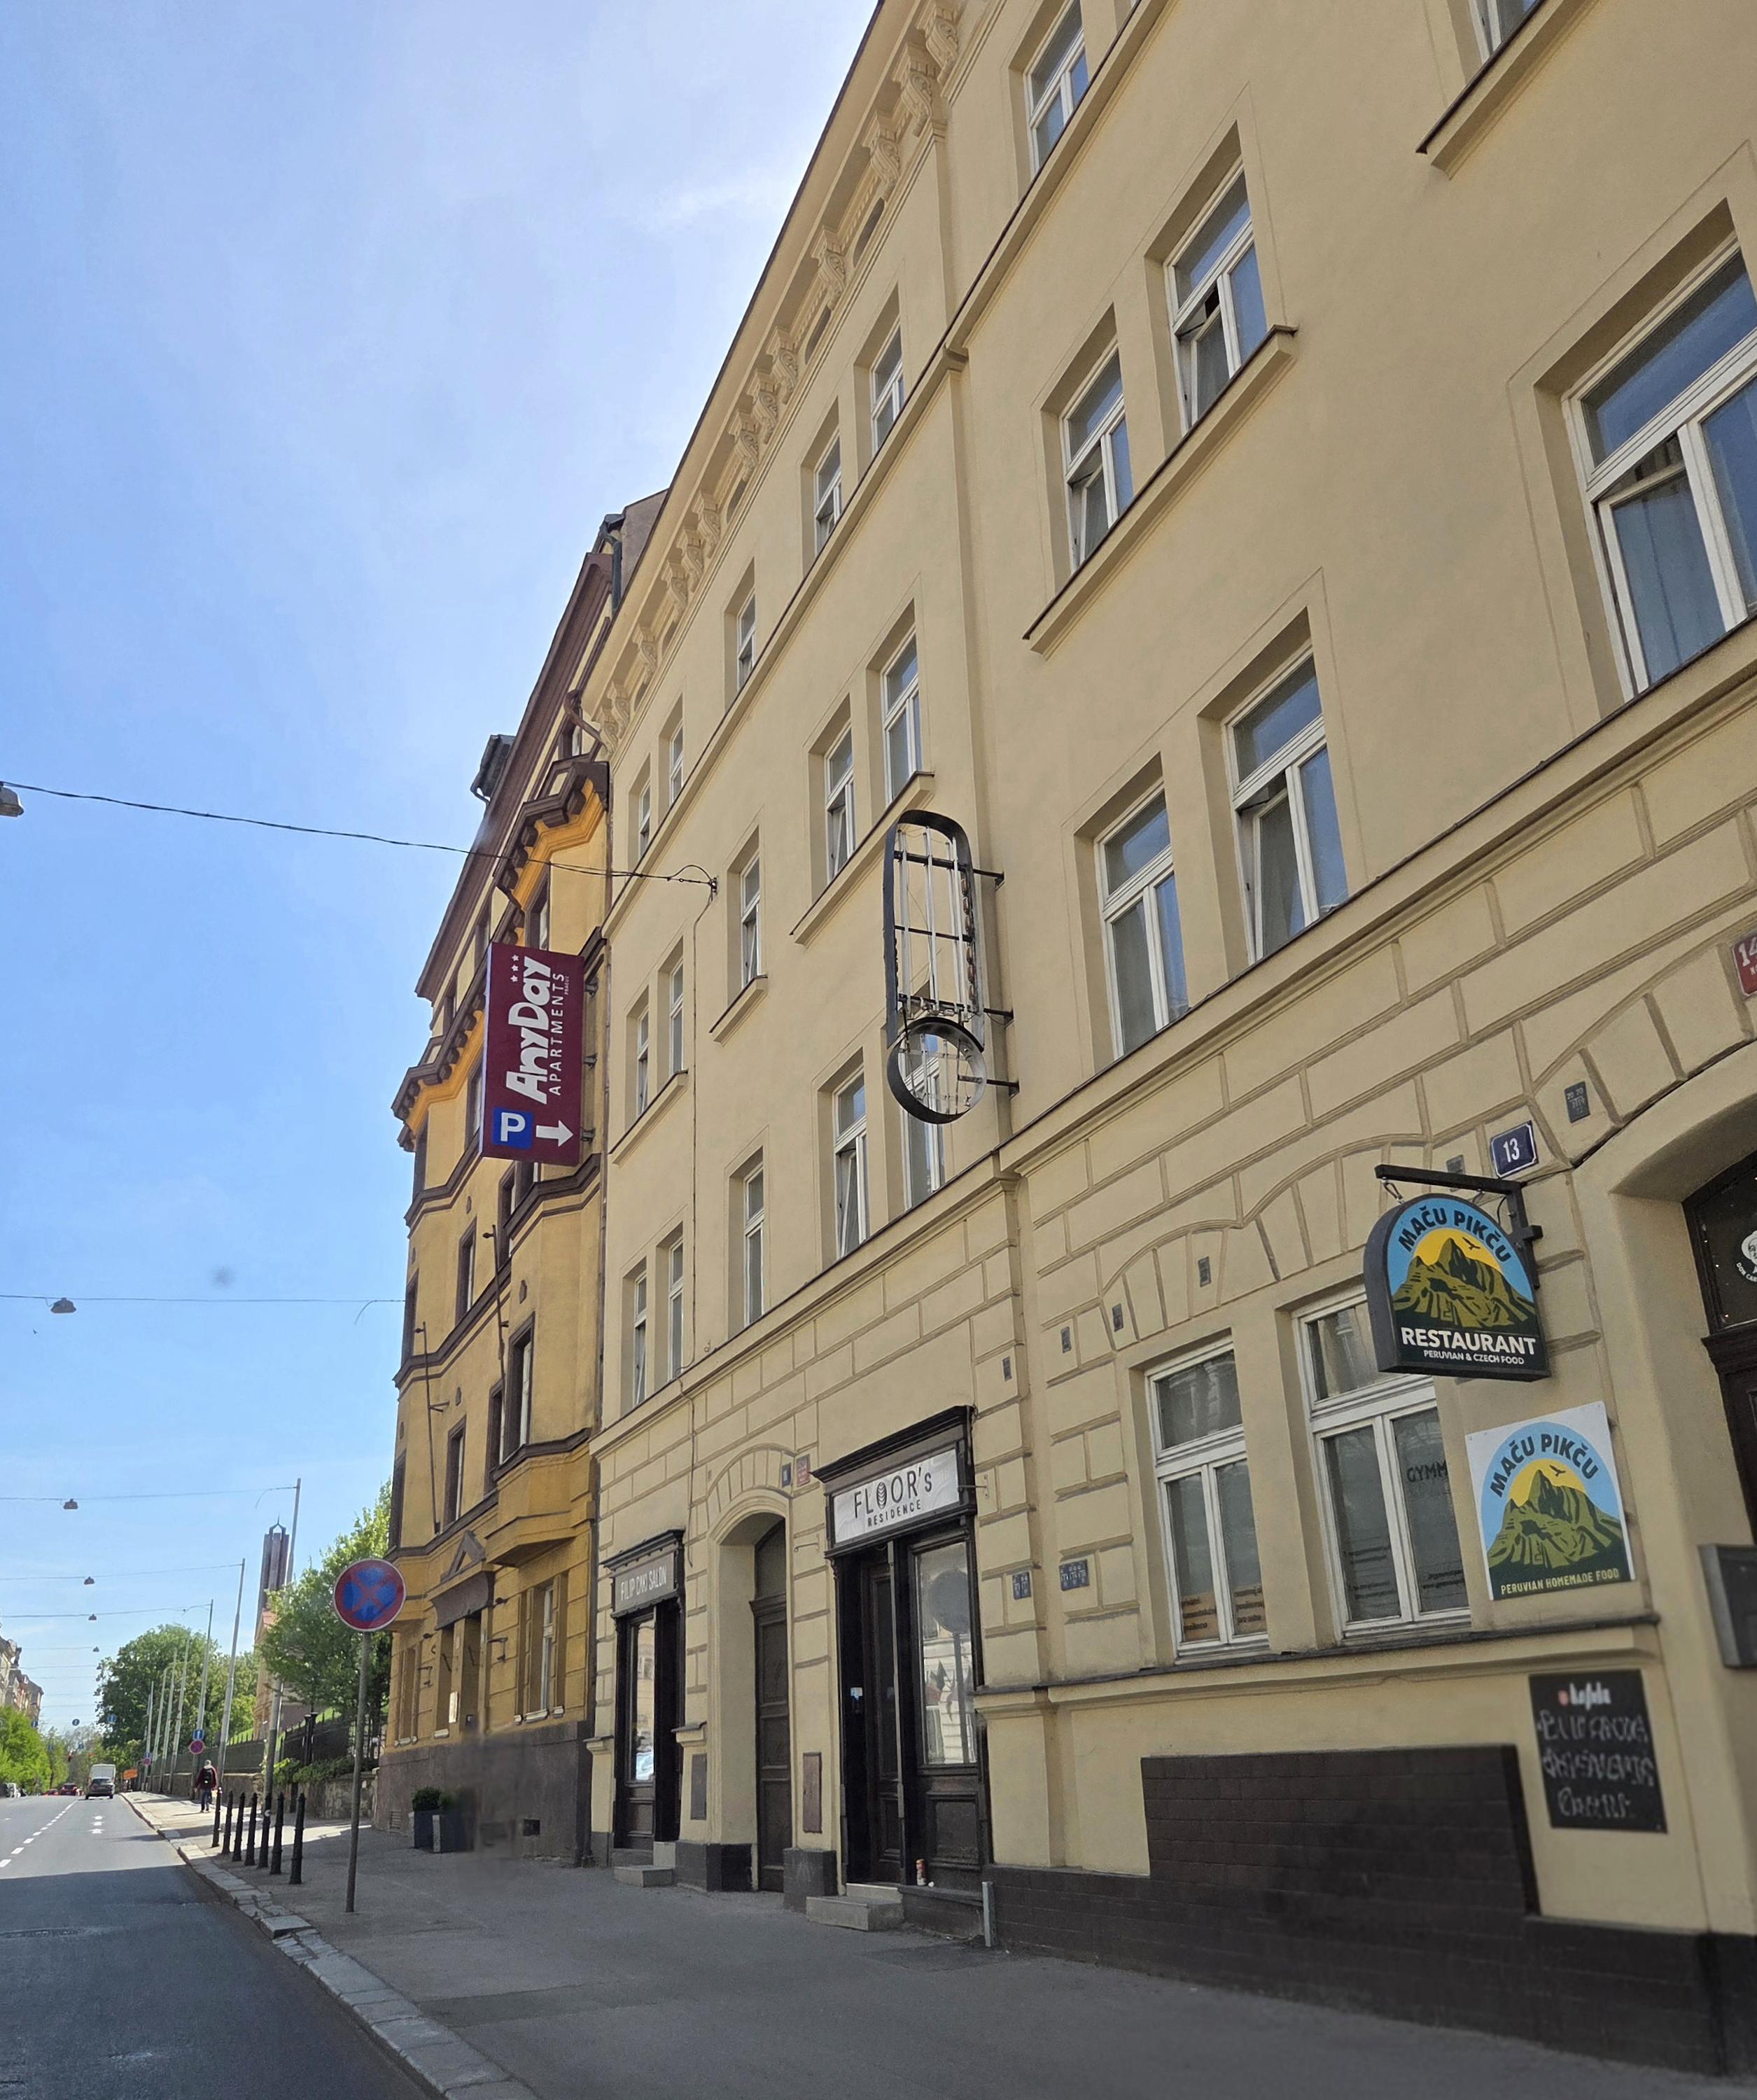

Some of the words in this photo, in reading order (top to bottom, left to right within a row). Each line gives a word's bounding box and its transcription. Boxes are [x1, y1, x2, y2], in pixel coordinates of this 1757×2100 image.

[505, 955, 552, 1105] AnyDay
[549, 973, 565, 1096] APARTMENTS
[500, 1112, 526, 1142] P
[1503, 1138, 1520, 1163] 13
[1398, 1205, 1448, 1252] MAČU
[1454, 1210, 1511, 1262] PIKČU
[1401, 1326, 1536, 1355] RESTAURANT
[1423, 1349, 1464, 1361] PERUVIAN
[1465, 1352, 1472, 1362] &
[1473, 1353, 1501, 1364] CZECH
[1501, 1355, 1525, 1365] FOOD
[1490, 1436, 1535, 1498] MAČU
[1540, 1433, 1599, 1480] PIKČU
[867, 1499, 922, 1527] RESIDENCE
[648, 1564, 666, 1590] SALON
[1500, 1578, 1544, 1595] PERUVIAN
[1546, 1572, 1594, 1589] HOMEMADE
[1596, 1567, 1619, 1581] FOOD
